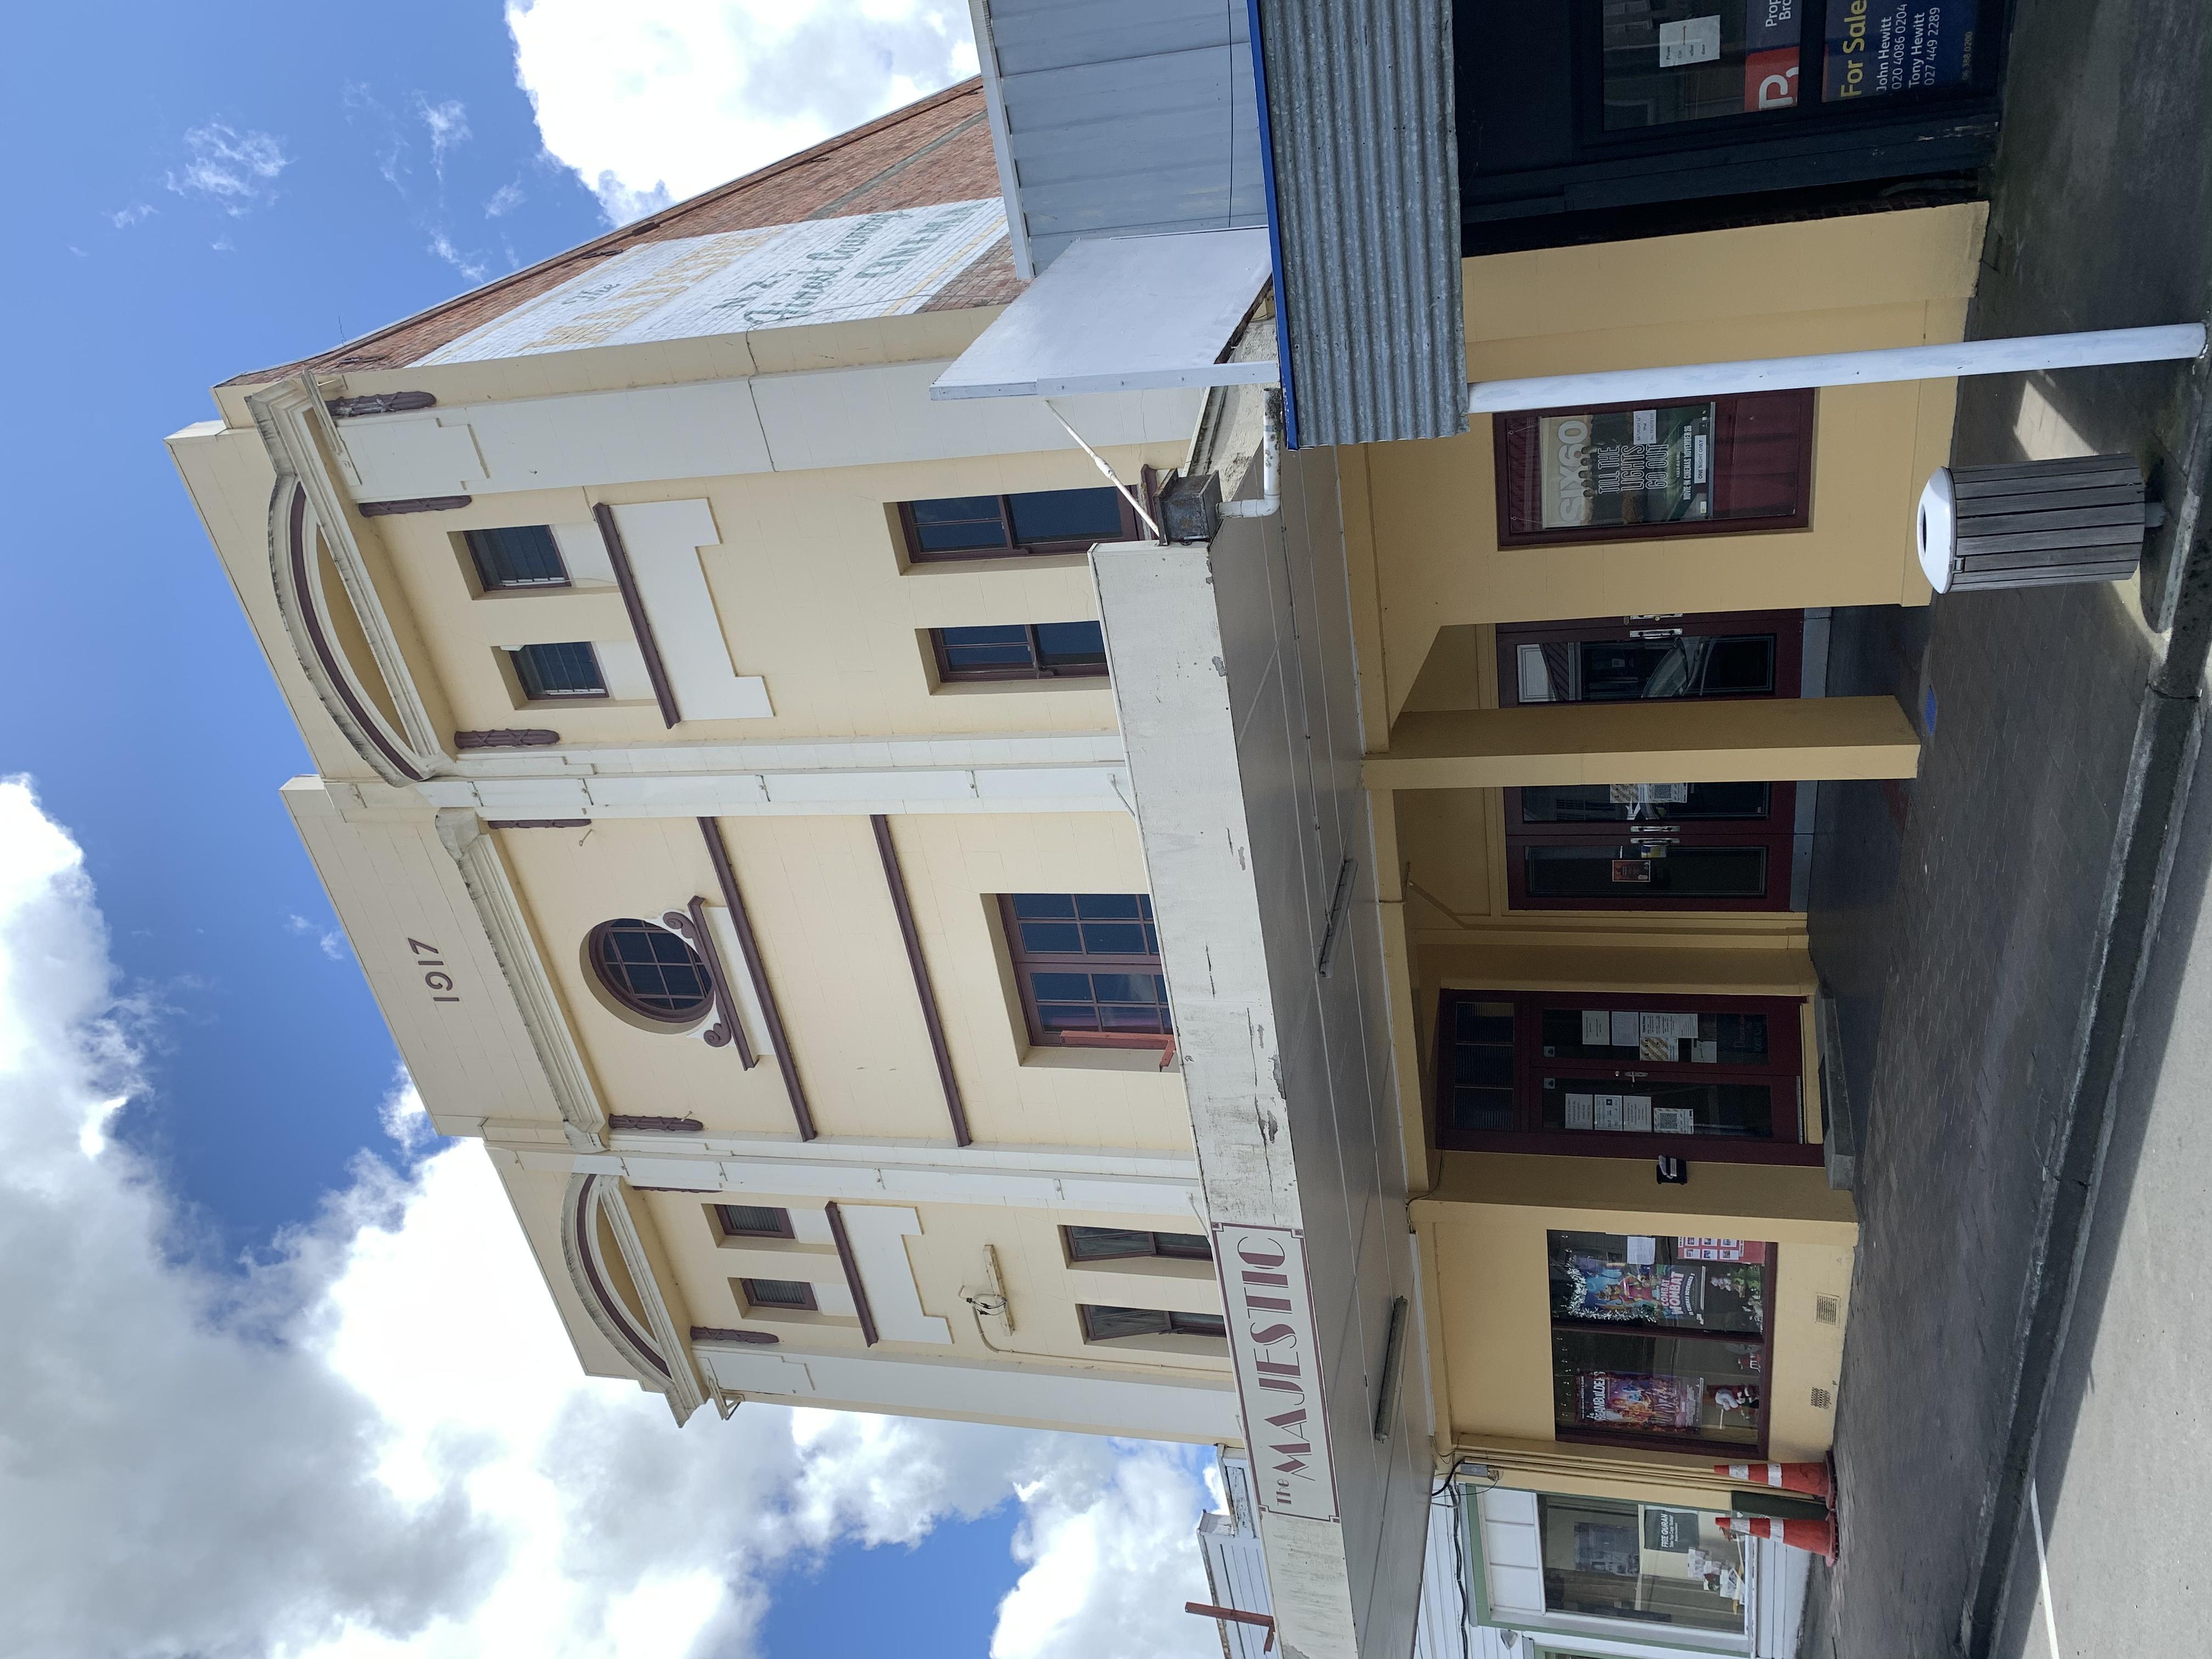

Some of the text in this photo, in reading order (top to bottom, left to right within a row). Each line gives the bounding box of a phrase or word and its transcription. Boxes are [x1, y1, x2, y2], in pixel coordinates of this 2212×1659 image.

[1841, 0, 1867, 97] For Sale
[1876, 16, 1892, 91] John Hewitt
[1892, 4, 1907, 89] 020 4086 0204
[1909, 12, 1925, 88] Tony Hewitt
[1924, 7, 1940, 86] 027 449 2289
[561, 283, 621, 306] The
[743, 267, 844, 325] Finest
[1558, 420, 1588, 521] SIX60
[1598, 447, 1620, 494] TILL THE
[1621, 444, 1645, 491] LIGHTS
[1645, 444, 1669, 489] GO OUT
[1683, 459, 1691, 478] CINEMAS
[408, 938, 459, 1001] 1917
[1661, 1279, 1669, 1306] COMBAT
[1669, 1272, 1684, 1314] WOMBAT
[1237, 1237, 1316, 1505] The MAJESTIC
[1592, 1371, 1606, 1421] REAMBUILDES
